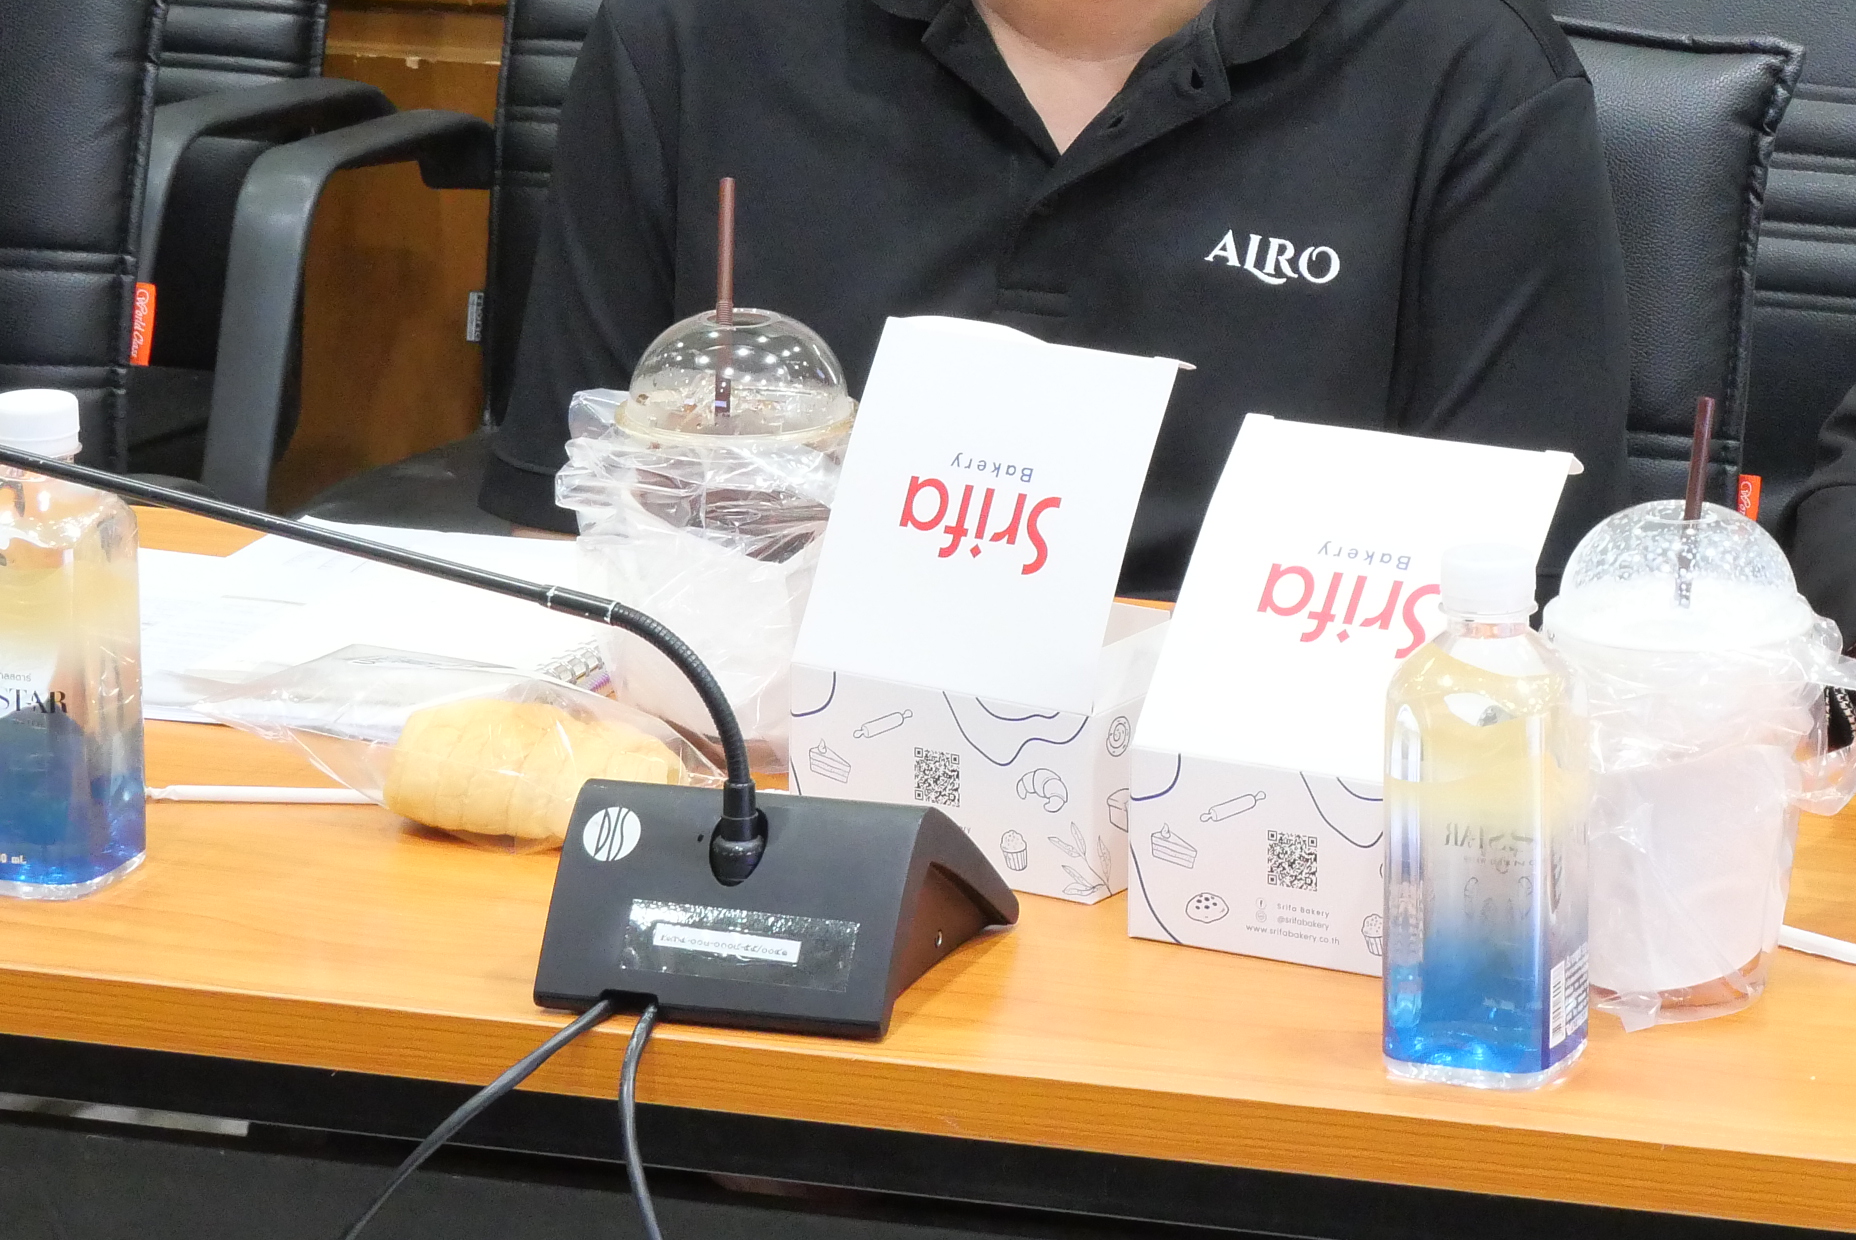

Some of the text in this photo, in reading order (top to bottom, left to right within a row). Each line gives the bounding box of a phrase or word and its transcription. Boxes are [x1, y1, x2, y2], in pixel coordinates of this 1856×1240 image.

[1204, 229, 1340, 285] ALRO
[951, 453, 1034, 483] Bakery
[899, 475, 1062, 575] Srifa
[1317, 540, 1411, 571] Bakery
[1257, 563, 1442, 659] Srifa
[1277, 915, 1330, 931] @srifabakery
[1300, 906, 1330, 919] Bakery
